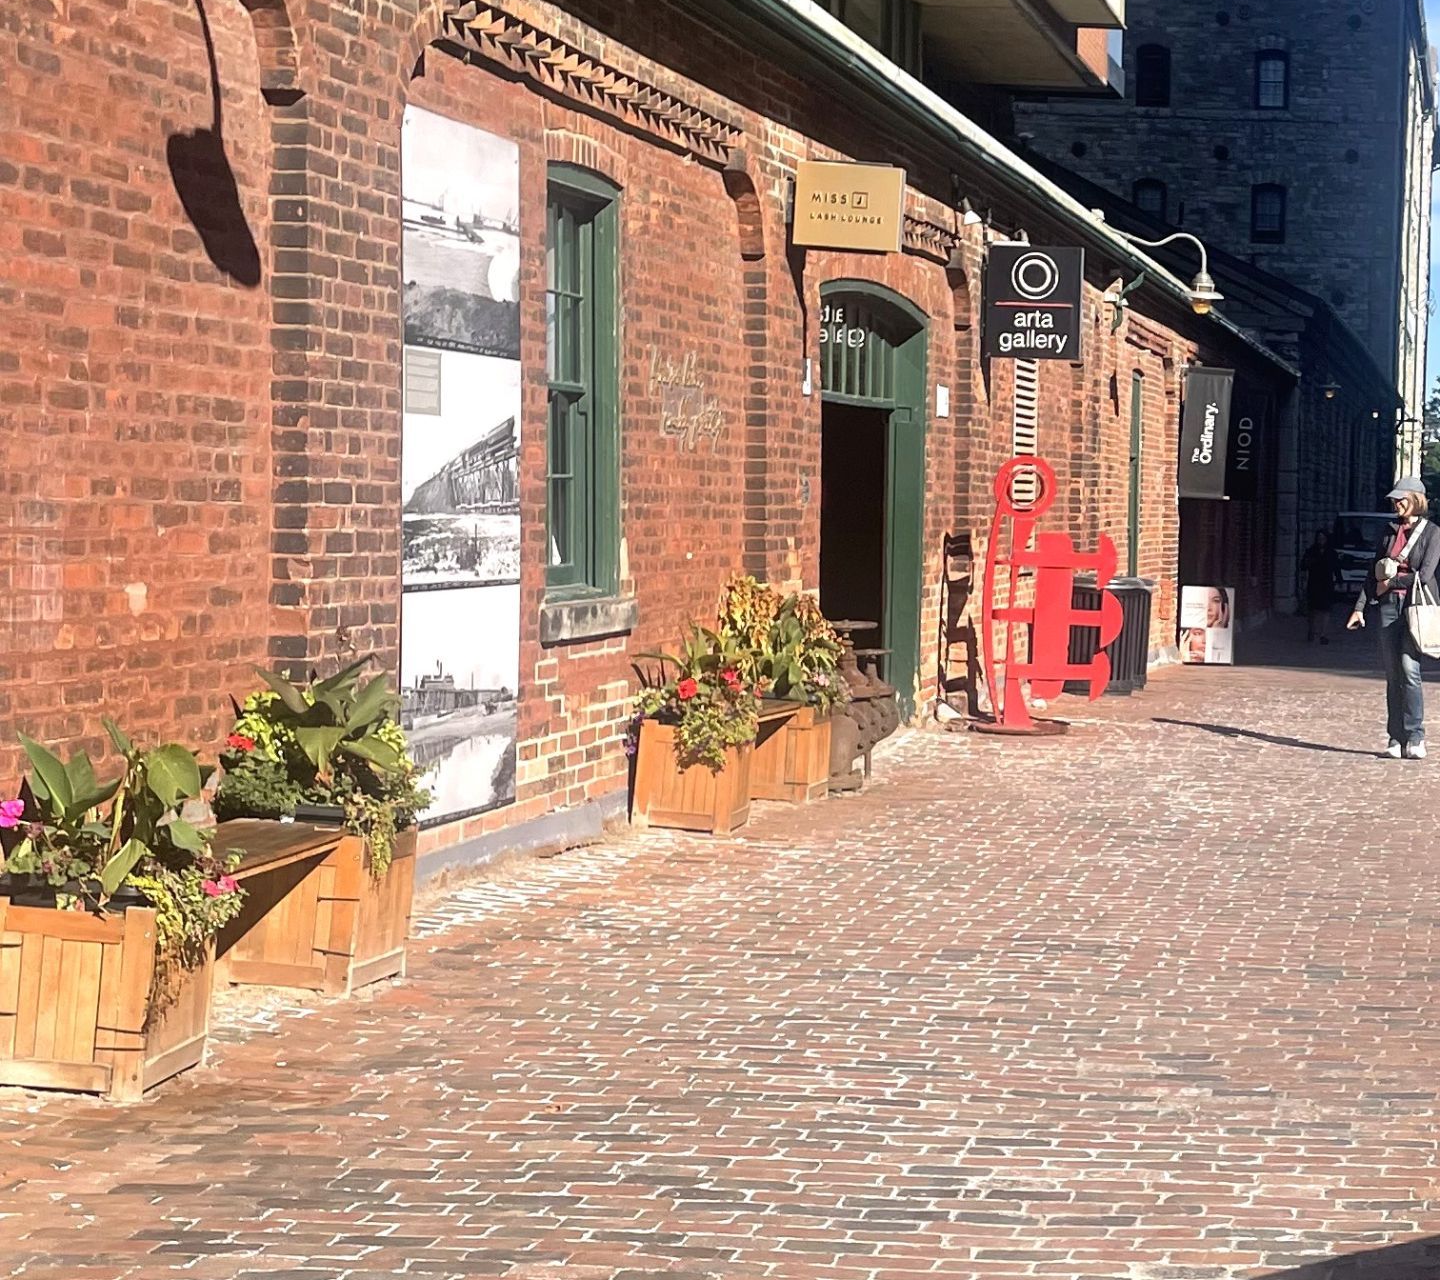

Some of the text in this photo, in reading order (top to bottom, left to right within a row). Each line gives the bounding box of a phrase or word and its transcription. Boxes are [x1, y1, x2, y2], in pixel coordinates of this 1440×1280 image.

[811, 193, 847, 205] MISS
[809, 213, 882, 225] LASH LOUNGE
[1013, 310, 1054, 329] arta
[999, 329, 1068, 354] gallery
[1199, 402, 1219, 464] Ordinary.
[1236, 417, 1253, 470] NIOD
[1191, 447, 1200, 464] The
